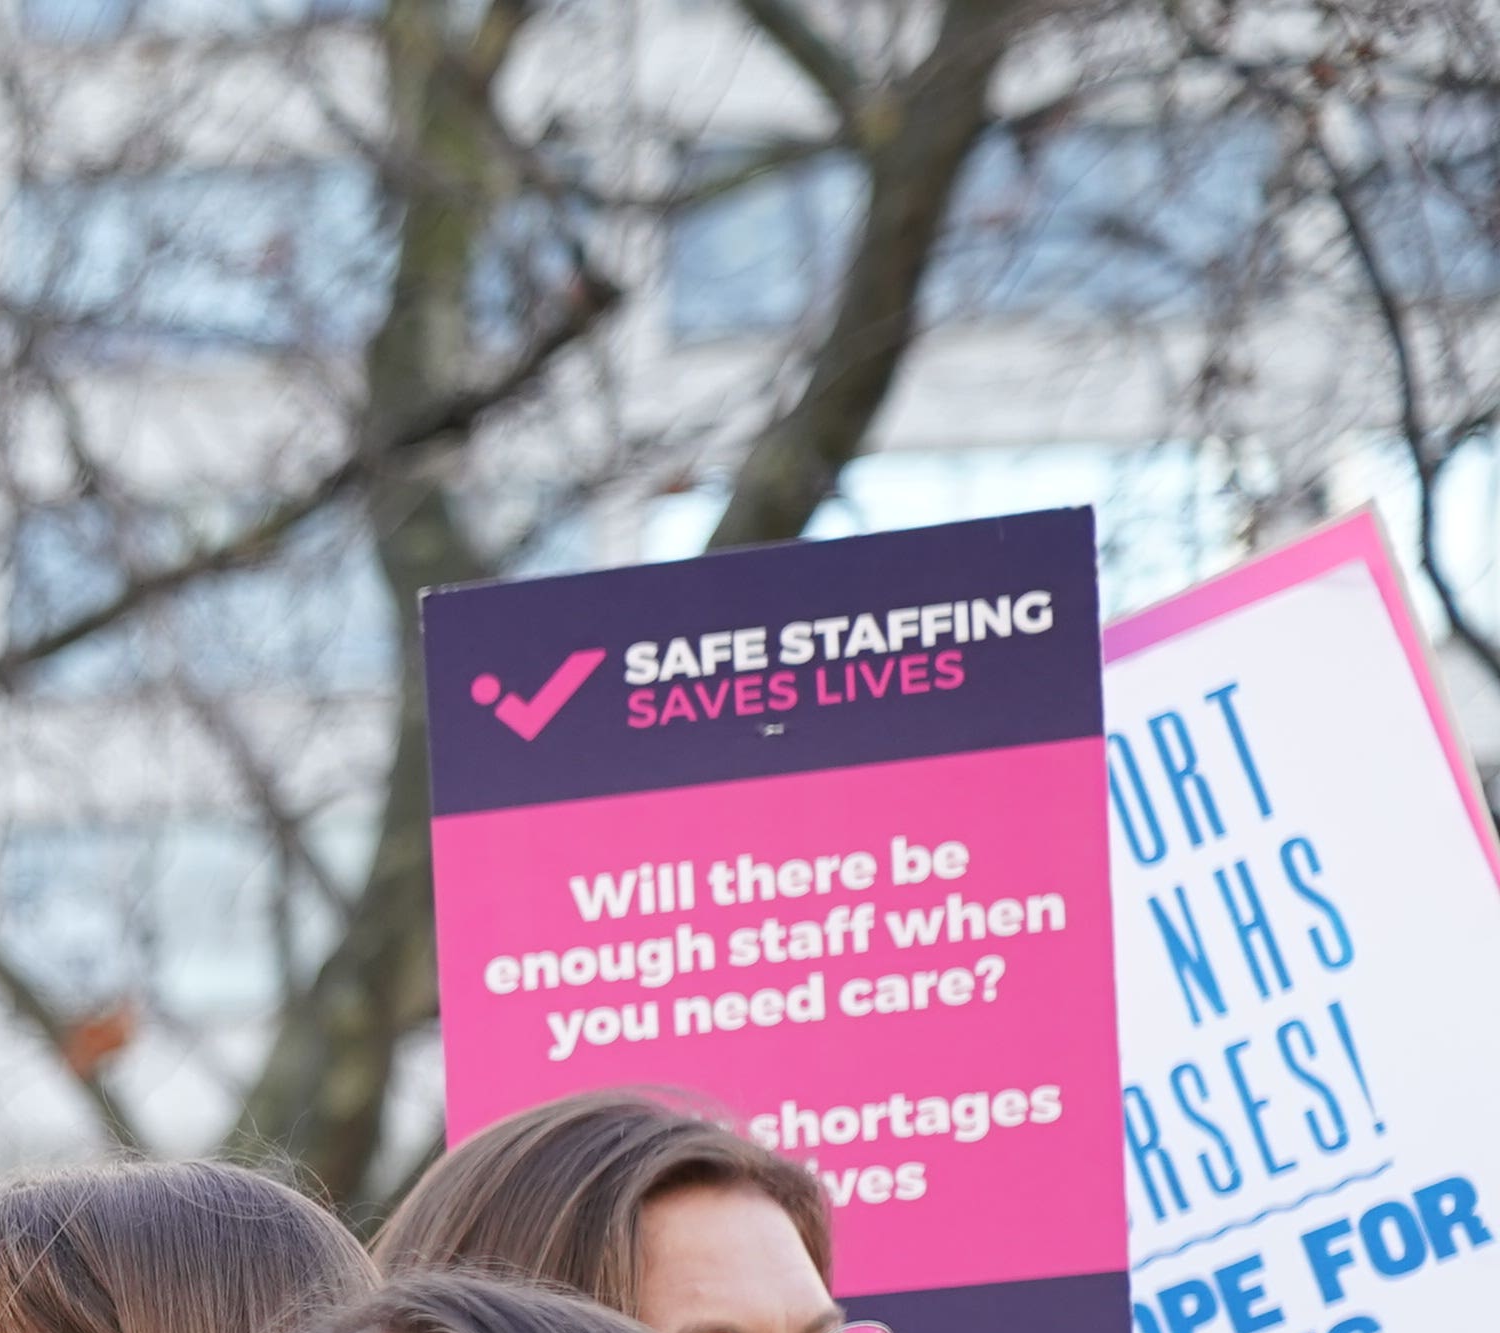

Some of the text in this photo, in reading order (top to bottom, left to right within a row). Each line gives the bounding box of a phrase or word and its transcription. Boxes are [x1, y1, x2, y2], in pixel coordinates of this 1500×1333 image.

[624, 589, 1054, 686] SAFE STAFFING
[626, 648, 967, 730] SAVES LIVES
[570, 835, 970, 923] Will there be
[483, 892, 1066, 995] enough staff when
[1147, 835, 1356, 1028] NHS
[547, 955, 1007, 1061] you need care?
[750, 1083, 1063, 1152] shortages
[1300, 1175, 1494, 1304] FOR
